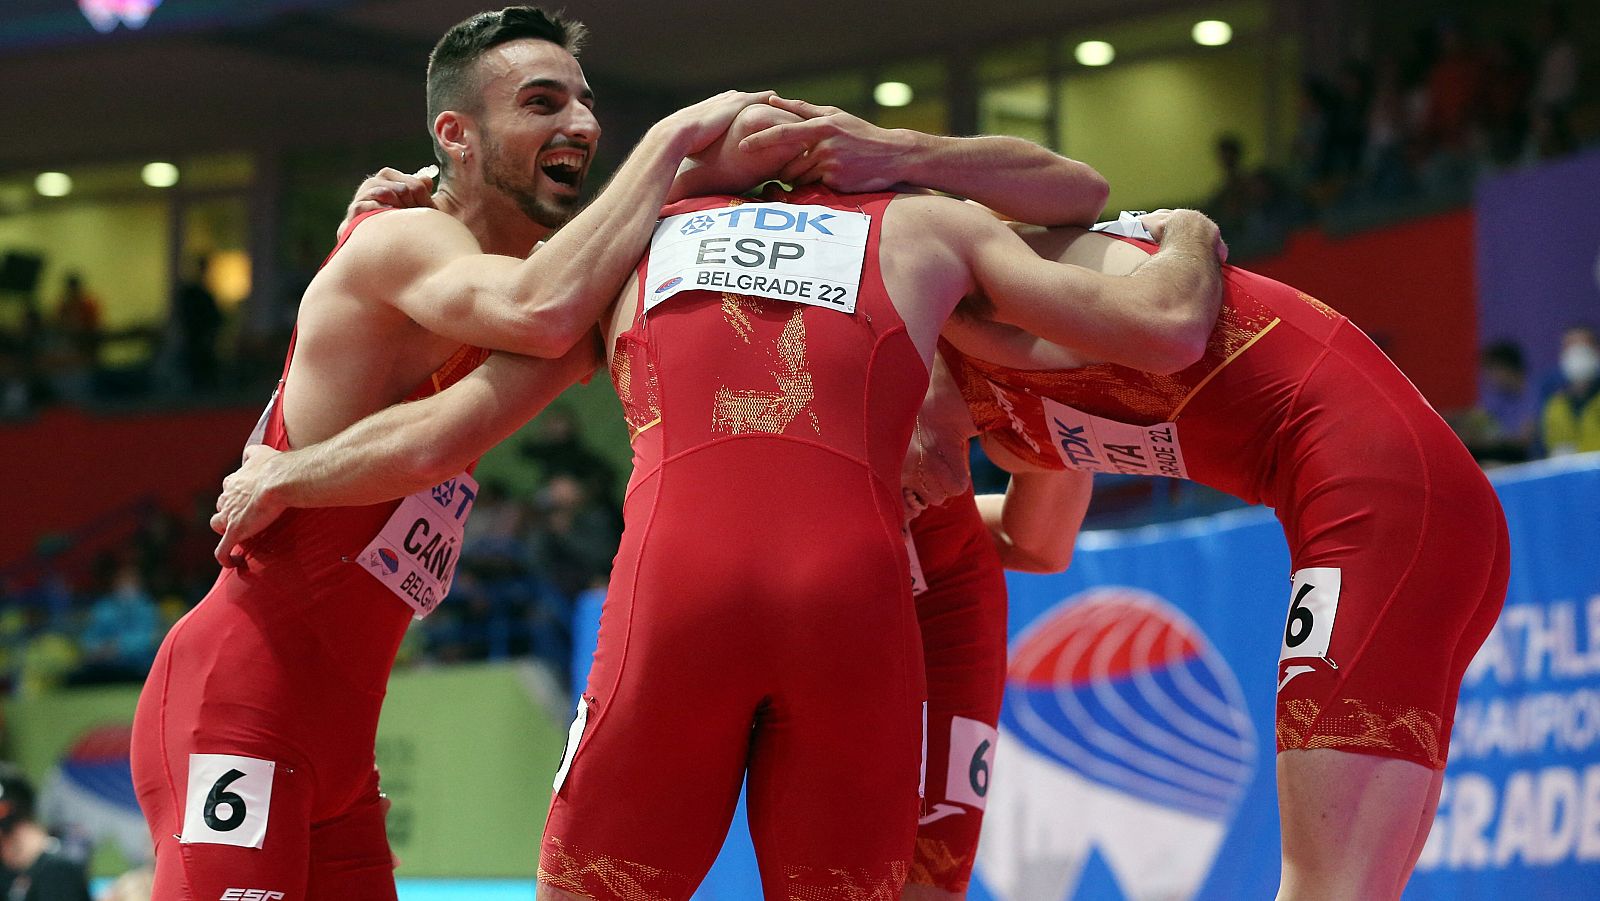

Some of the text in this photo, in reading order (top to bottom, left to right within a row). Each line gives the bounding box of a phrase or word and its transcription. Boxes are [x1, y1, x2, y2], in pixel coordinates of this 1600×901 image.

[717, 207, 837, 235] TDK
[696, 237, 805, 270] ESP
[697, 271, 847, 306] BELGRADE 22
[1053, 416, 1101, 466] TDK
[1148, 427, 1173, 443] 22
[455, 483, 476, 520] T
[1285, 582, 1316, 648] 6
[969, 738, 991, 798] 6
[203, 768, 247, 832] 6
[219, 887, 286, 901] ESP
